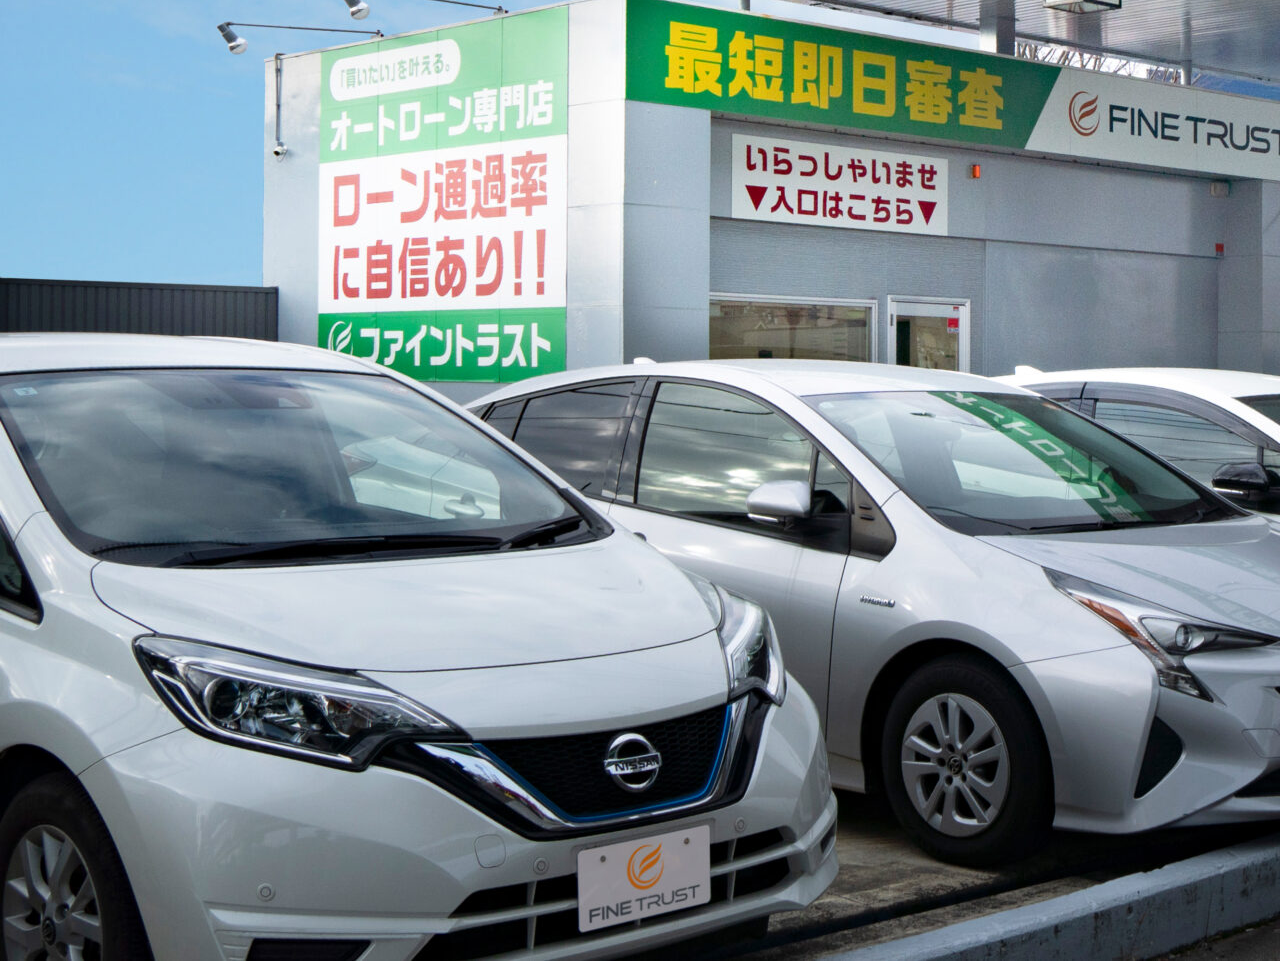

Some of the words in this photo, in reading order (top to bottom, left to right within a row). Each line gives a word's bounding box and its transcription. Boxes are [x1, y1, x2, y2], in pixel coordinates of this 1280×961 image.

[340, 54, 453, 89] 「買いたい」を叶える。
[665, 21, 1004, 130] 最短即日審査
[329, 80, 554, 152] オートローン専門店
[1107, 104, 1181, 142] FINE
[333, 150, 548, 228] ローン通過率
[745, 144, 938, 191] いらっしゃいませ
[771, 189, 914, 226] 入口はこちら
[360, 323, 552, 368] ファイントラスト
[614, 758, 660, 772] NISSAN
[588, 899, 633, 924] FINE
[634, 883, 701, 912] TRUST
